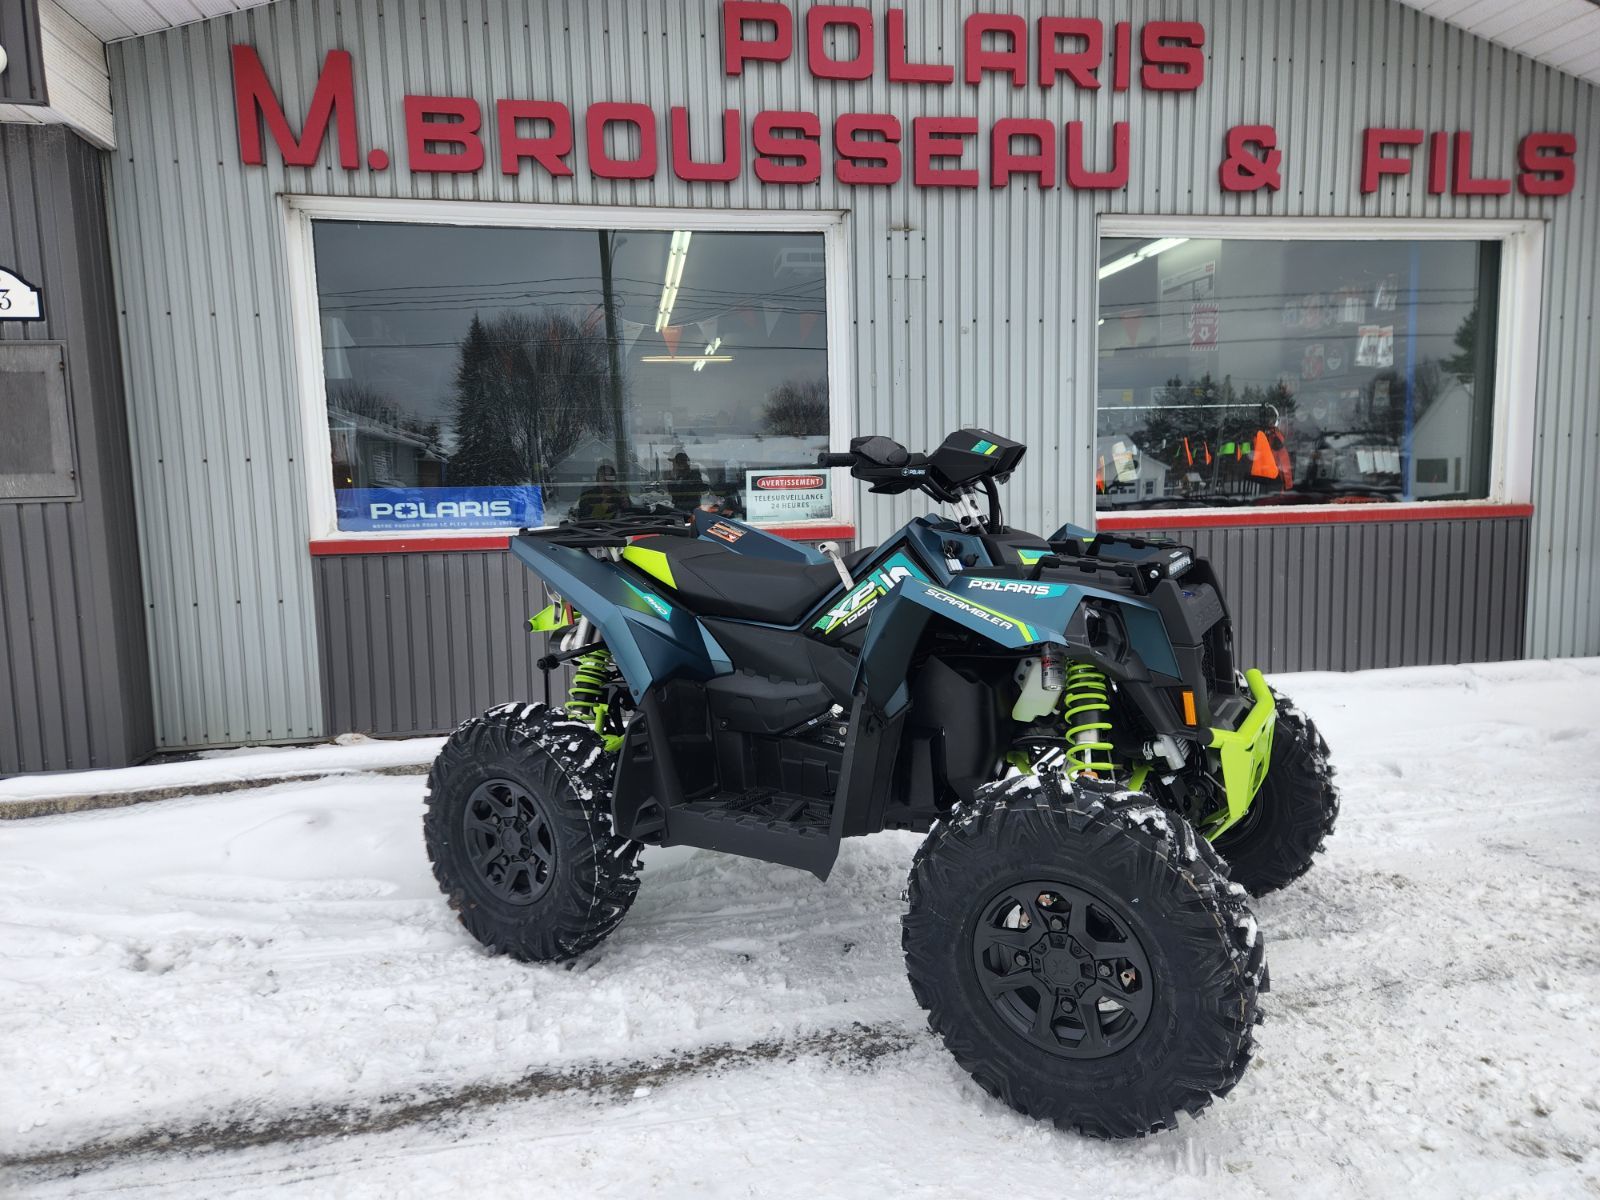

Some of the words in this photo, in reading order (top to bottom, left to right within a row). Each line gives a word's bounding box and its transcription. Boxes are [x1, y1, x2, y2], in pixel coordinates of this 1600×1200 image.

[724, 0, 1205, 92] POLARIS
[1219, 125, 1282, 193] &
[1360, 127, 1577, 197] FILS
[761, 478, 820, 487] AVERTISSEMENT
[370, 500, 512, 519] POLARIS
[968, 579, 1050, 595] POLARIS
[842, 598, 878, 627] 1000
[924, 588, 1014, 630] SCRAMBLER
